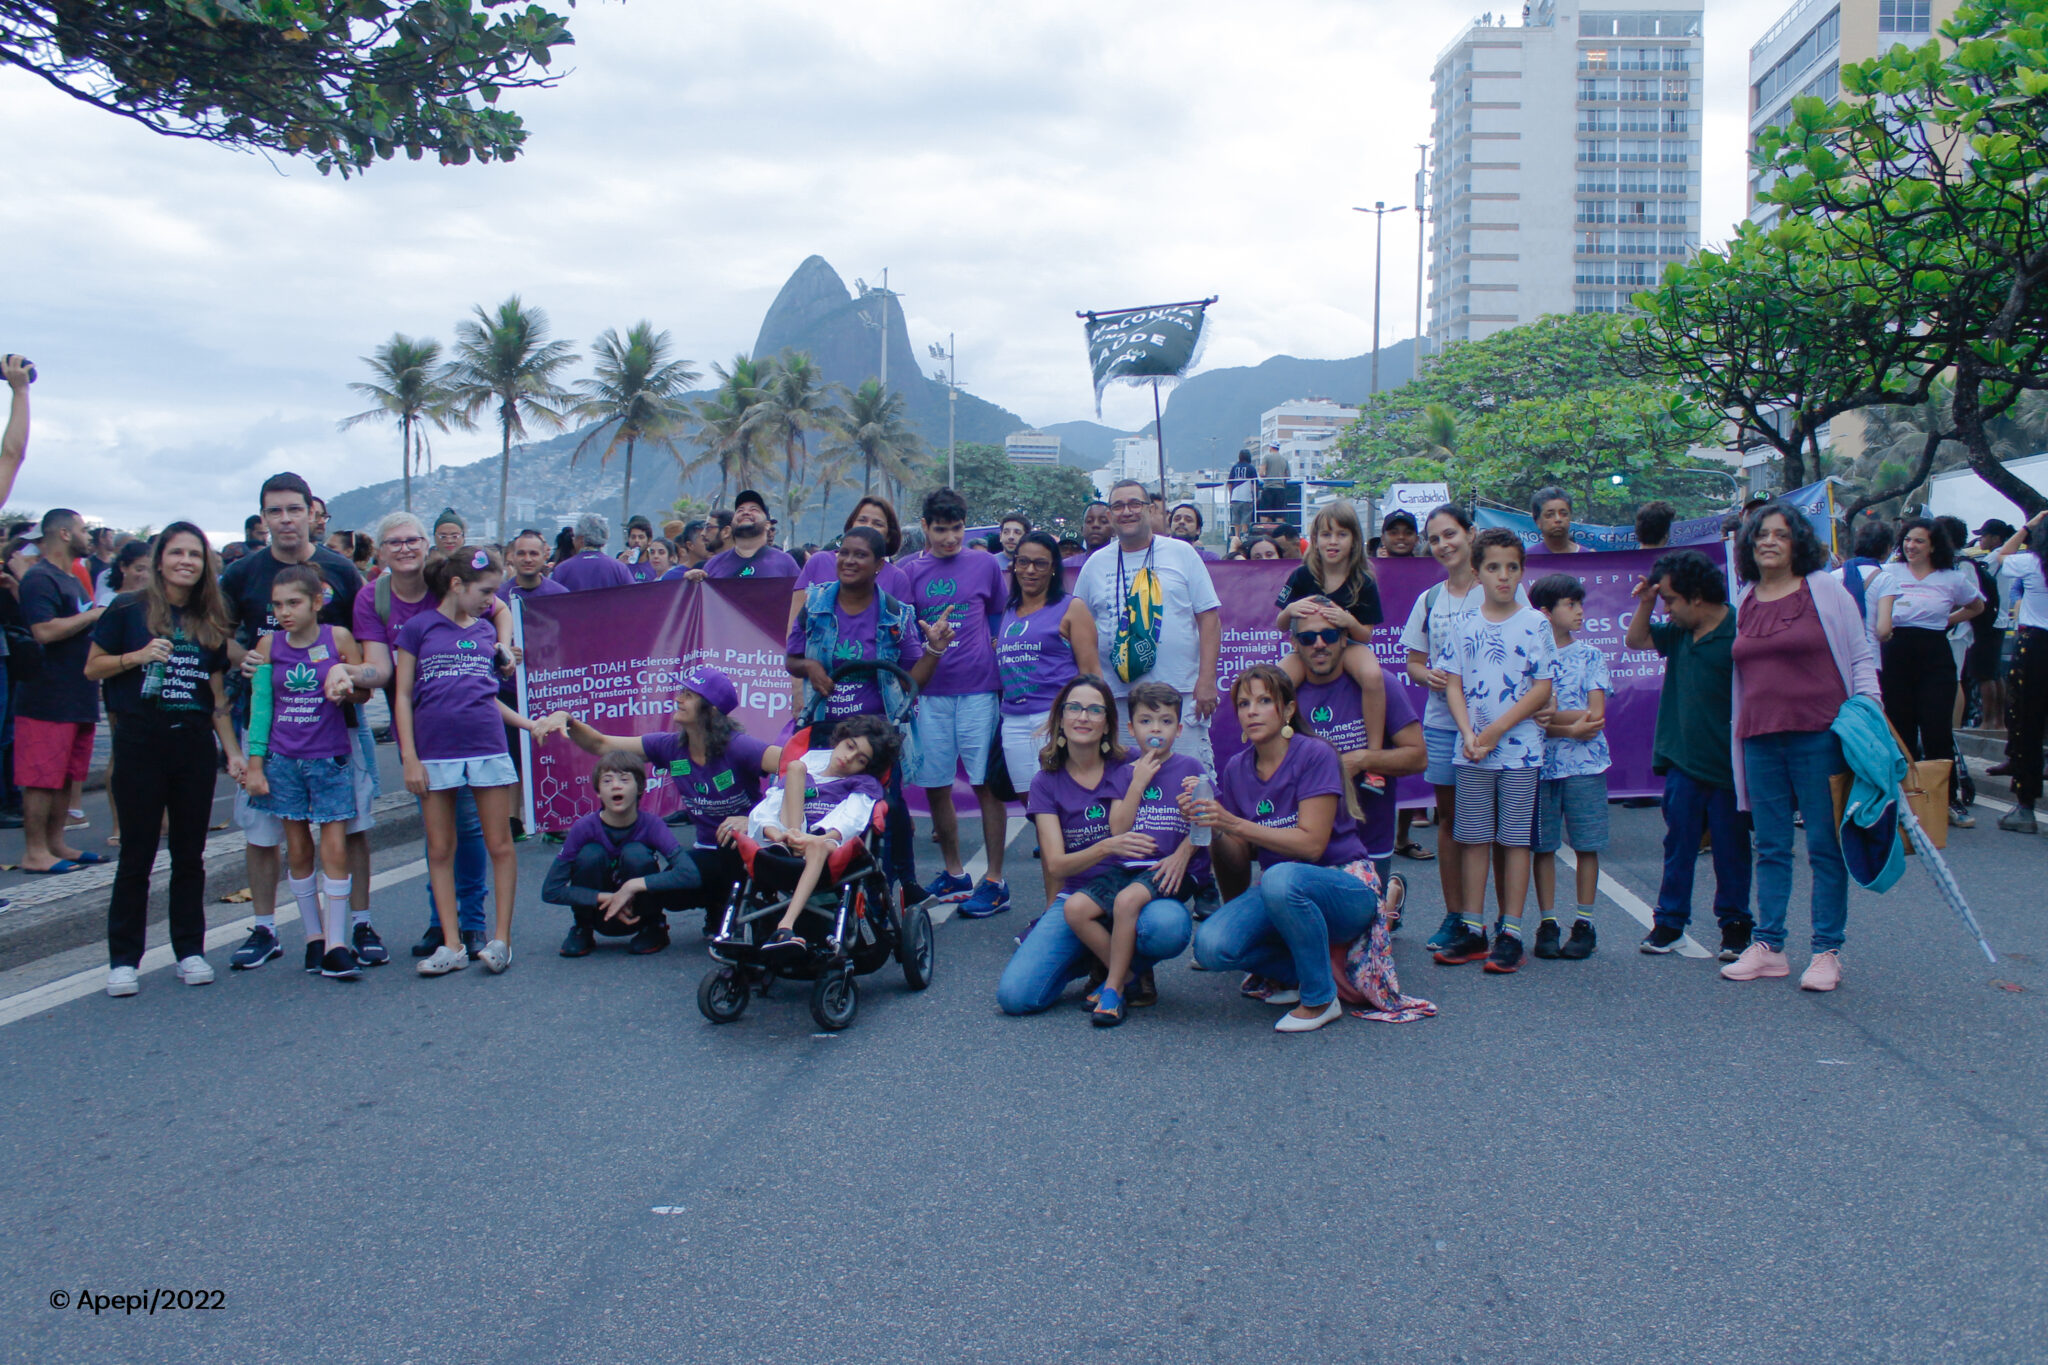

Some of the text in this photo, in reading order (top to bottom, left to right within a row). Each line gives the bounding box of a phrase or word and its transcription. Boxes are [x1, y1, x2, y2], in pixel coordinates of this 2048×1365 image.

[1397, 489, 1449, 504] Canabidiol
[1001, 641, 1042, 653] Medicinal
[1220, 642, 1277, 655] bromialgia
[1620, 649, 1667, 663] Autis
[527, 666, 588, 684] Alzheimer
[591, 660, 627, 676] TDAH
[630, 656, 680, 668] Esclerose
[725, 649, 785, 666] Parkin
[1637, 665, 1655, 677] de
[527, 683, 581, 701] Autismo
[582, 674, 632, 692] Dores
[760, 668, 790, 679] Auto
[528, 702, 542, 712] TOC
[546, 695, 588, 712] Epilepsia
[589, 688, 639, 700] Transtorno
[641, 685, 653, 695] de
[751, 679, 792, 689] Alzheim
[831, 702, 863, 716] apoiar
[575, 776, 591, 785] OH
[1139, 804, 1181, 816] Alzheime
[1084, 823, 1111, 836] Alzhe
